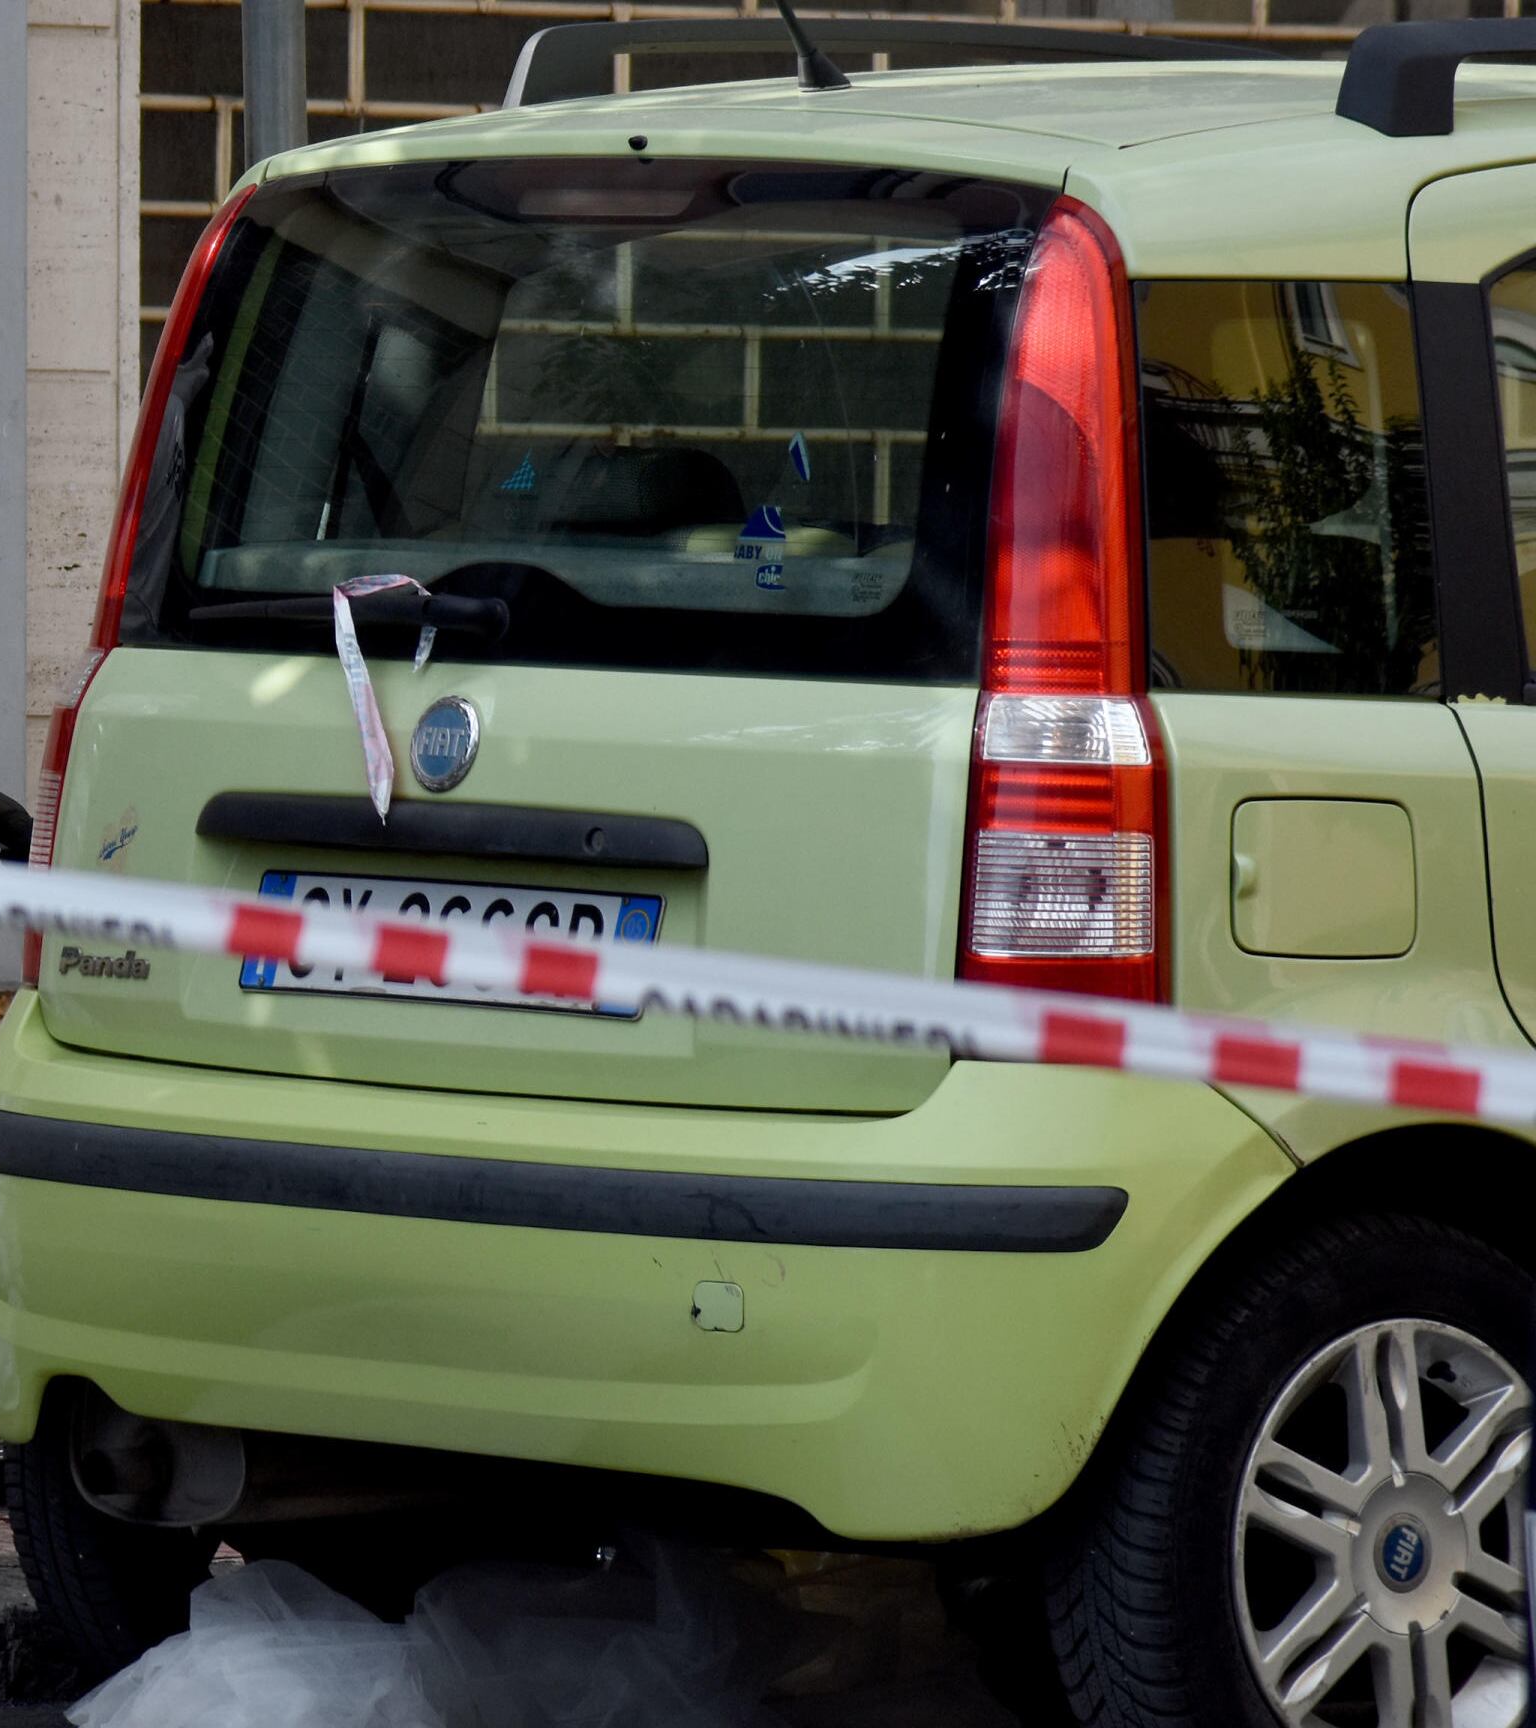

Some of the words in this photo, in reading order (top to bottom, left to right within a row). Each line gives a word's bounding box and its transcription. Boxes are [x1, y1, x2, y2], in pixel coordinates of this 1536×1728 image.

[734, 543, 763, 560] ABY
[416, 727, 465, 757] FIAT
[59, 946, 151, 980] Panda
[1390, 1527, 1418, 1580] FIAT
